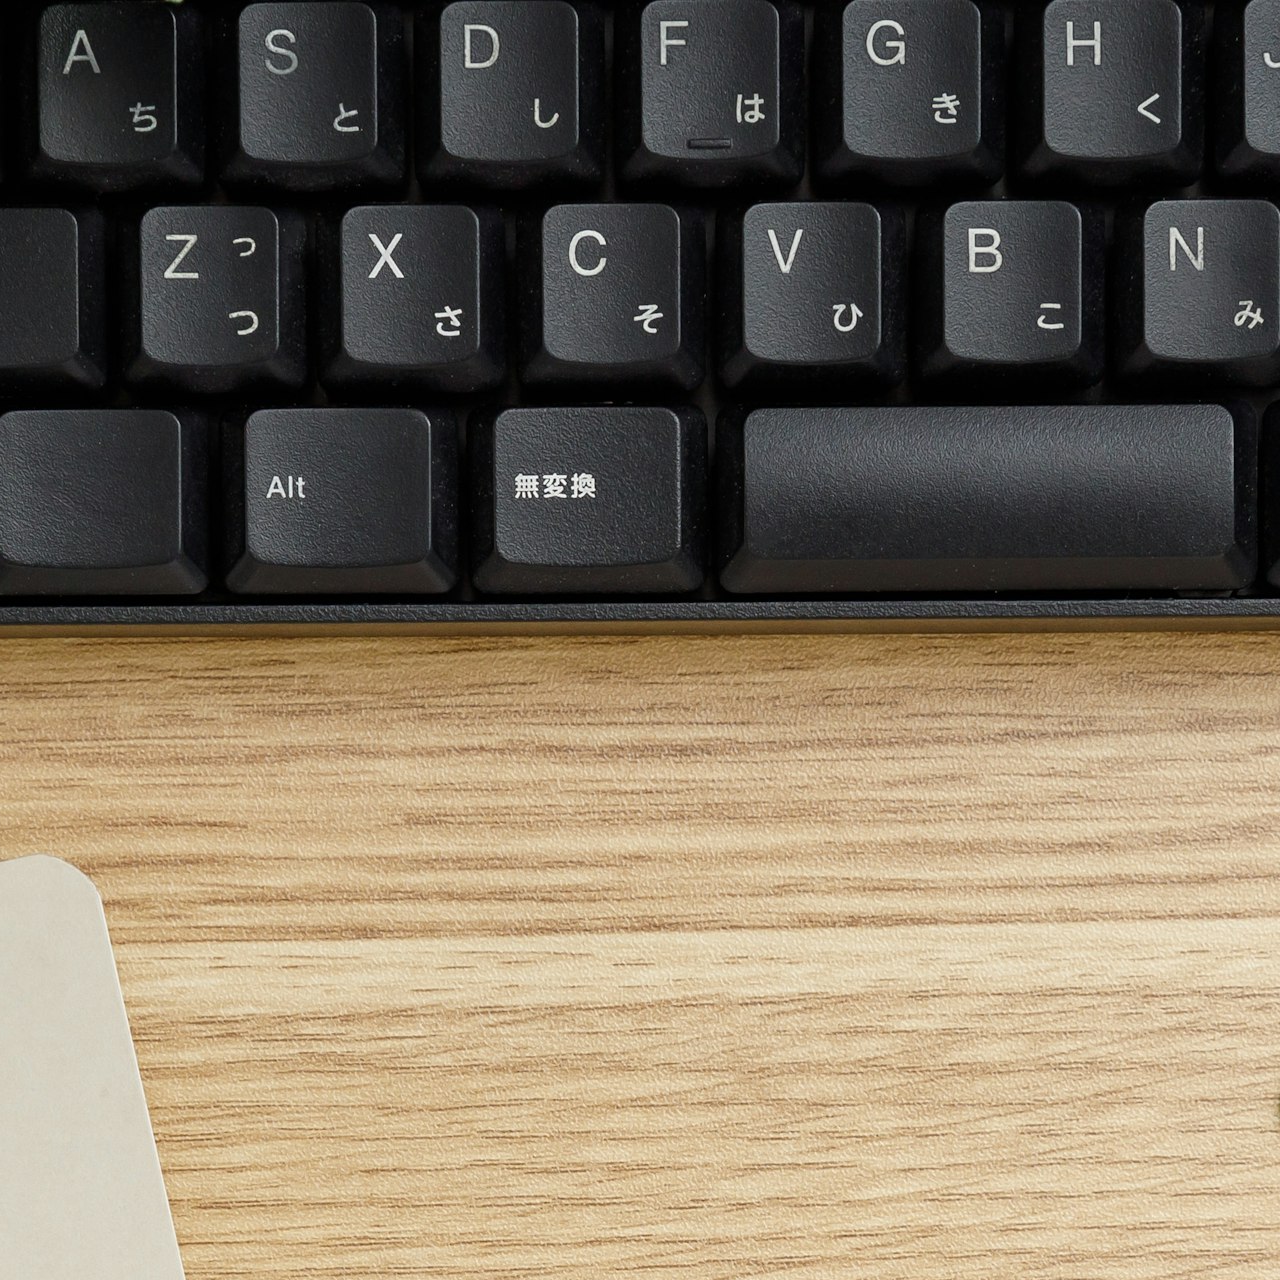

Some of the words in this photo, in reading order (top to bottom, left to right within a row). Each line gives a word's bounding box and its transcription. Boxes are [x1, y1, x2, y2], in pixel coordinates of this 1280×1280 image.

[62, 29, 101, 75] A
[264, 29, 298, 75] S
[463, 24, 500, 69] D
[659, 20, 689, 65] F
[866, 19, 906, 66] G
[1066, 21, 1101, 66] H
[129, 102, 158, 133] ち
[333, 102, 360, 133] と
[534, 98, 560, 129] し
[735, 93, 766, 124] は
[931, 92, 961, 124] き
[1137, 93, 1161, 124] く
[163, 234, 199, 279] Z
[368, 233, 405, 279] X
[568, 229, 607, 276] C
[767, 228, 804, 274] V
[968, 227, 1003, 273] B
[1169, 226, 1204, 271] N
[228, 310, 259, 336] つ
[434, 305, 463, 337] さ
[633, 304, 664, 334] そ
[832, 303, 864, 332] ひ
[1036, 302, 1065, 330] こ
[1233, 300, 1265, 330] み
[266, 475, 306, 499] Alt
[514, 472, 596, 499] 無変換
